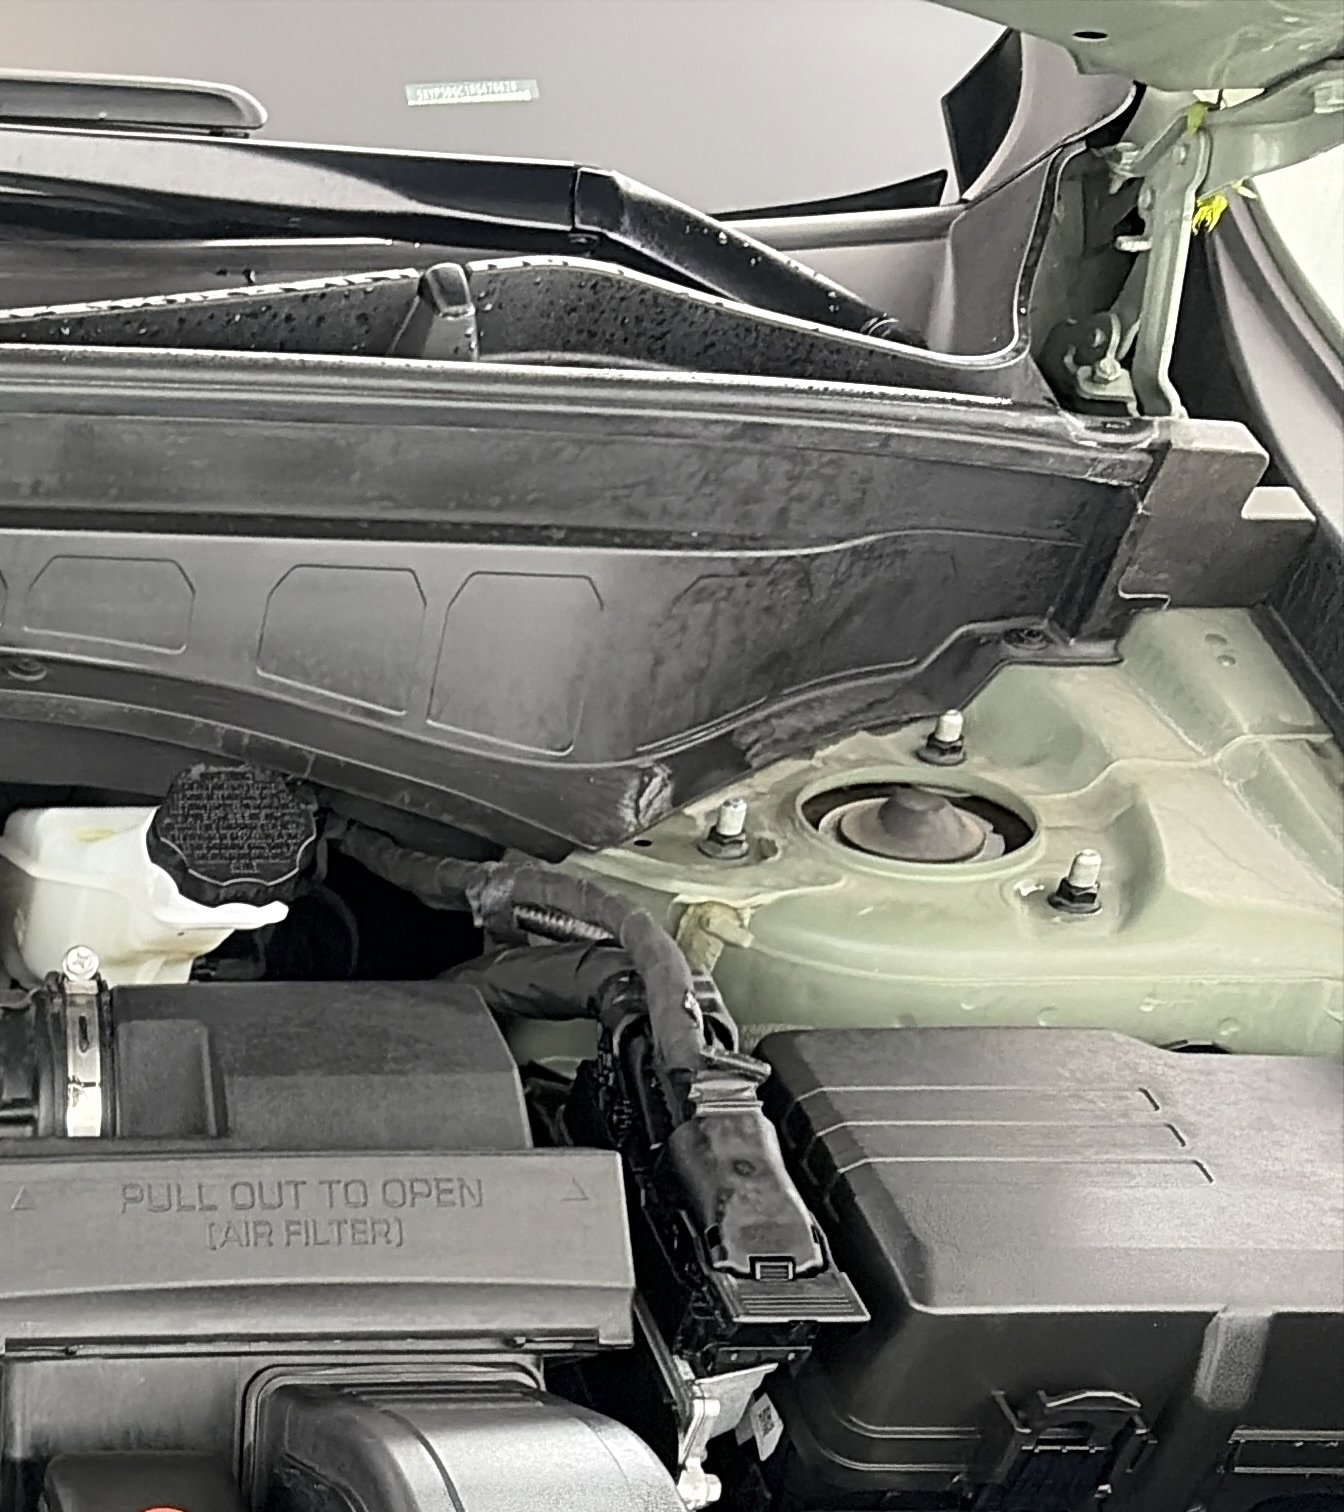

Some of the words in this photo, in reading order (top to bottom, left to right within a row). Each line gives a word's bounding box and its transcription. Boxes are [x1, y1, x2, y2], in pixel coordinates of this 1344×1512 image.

[121, 1181, 218, 1214] PULL
[229, 1179, 307, 1212] OUT
[318, 1178, 369, 1210] TO
[381, 1176, 485, 1209] OPEN
